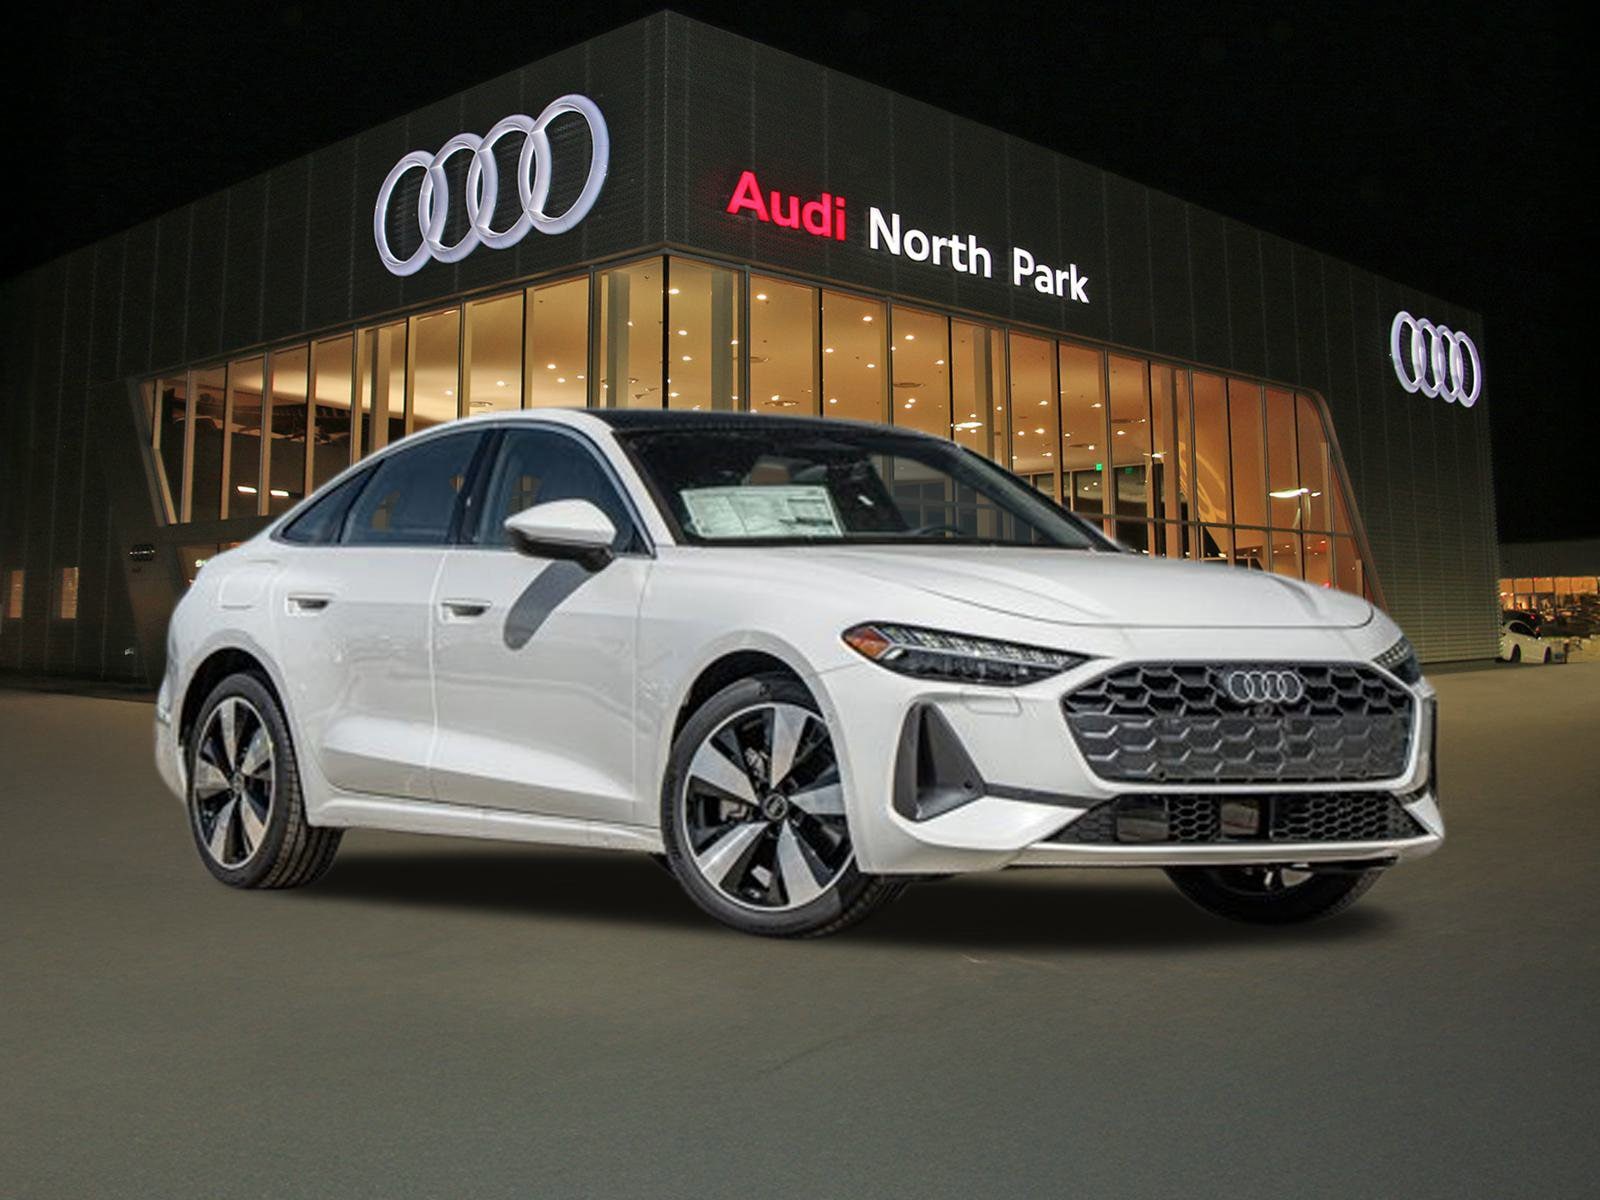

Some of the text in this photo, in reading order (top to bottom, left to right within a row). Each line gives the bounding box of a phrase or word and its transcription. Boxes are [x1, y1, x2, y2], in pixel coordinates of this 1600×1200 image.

[727, 171, 1090, 304] Audi North Park
